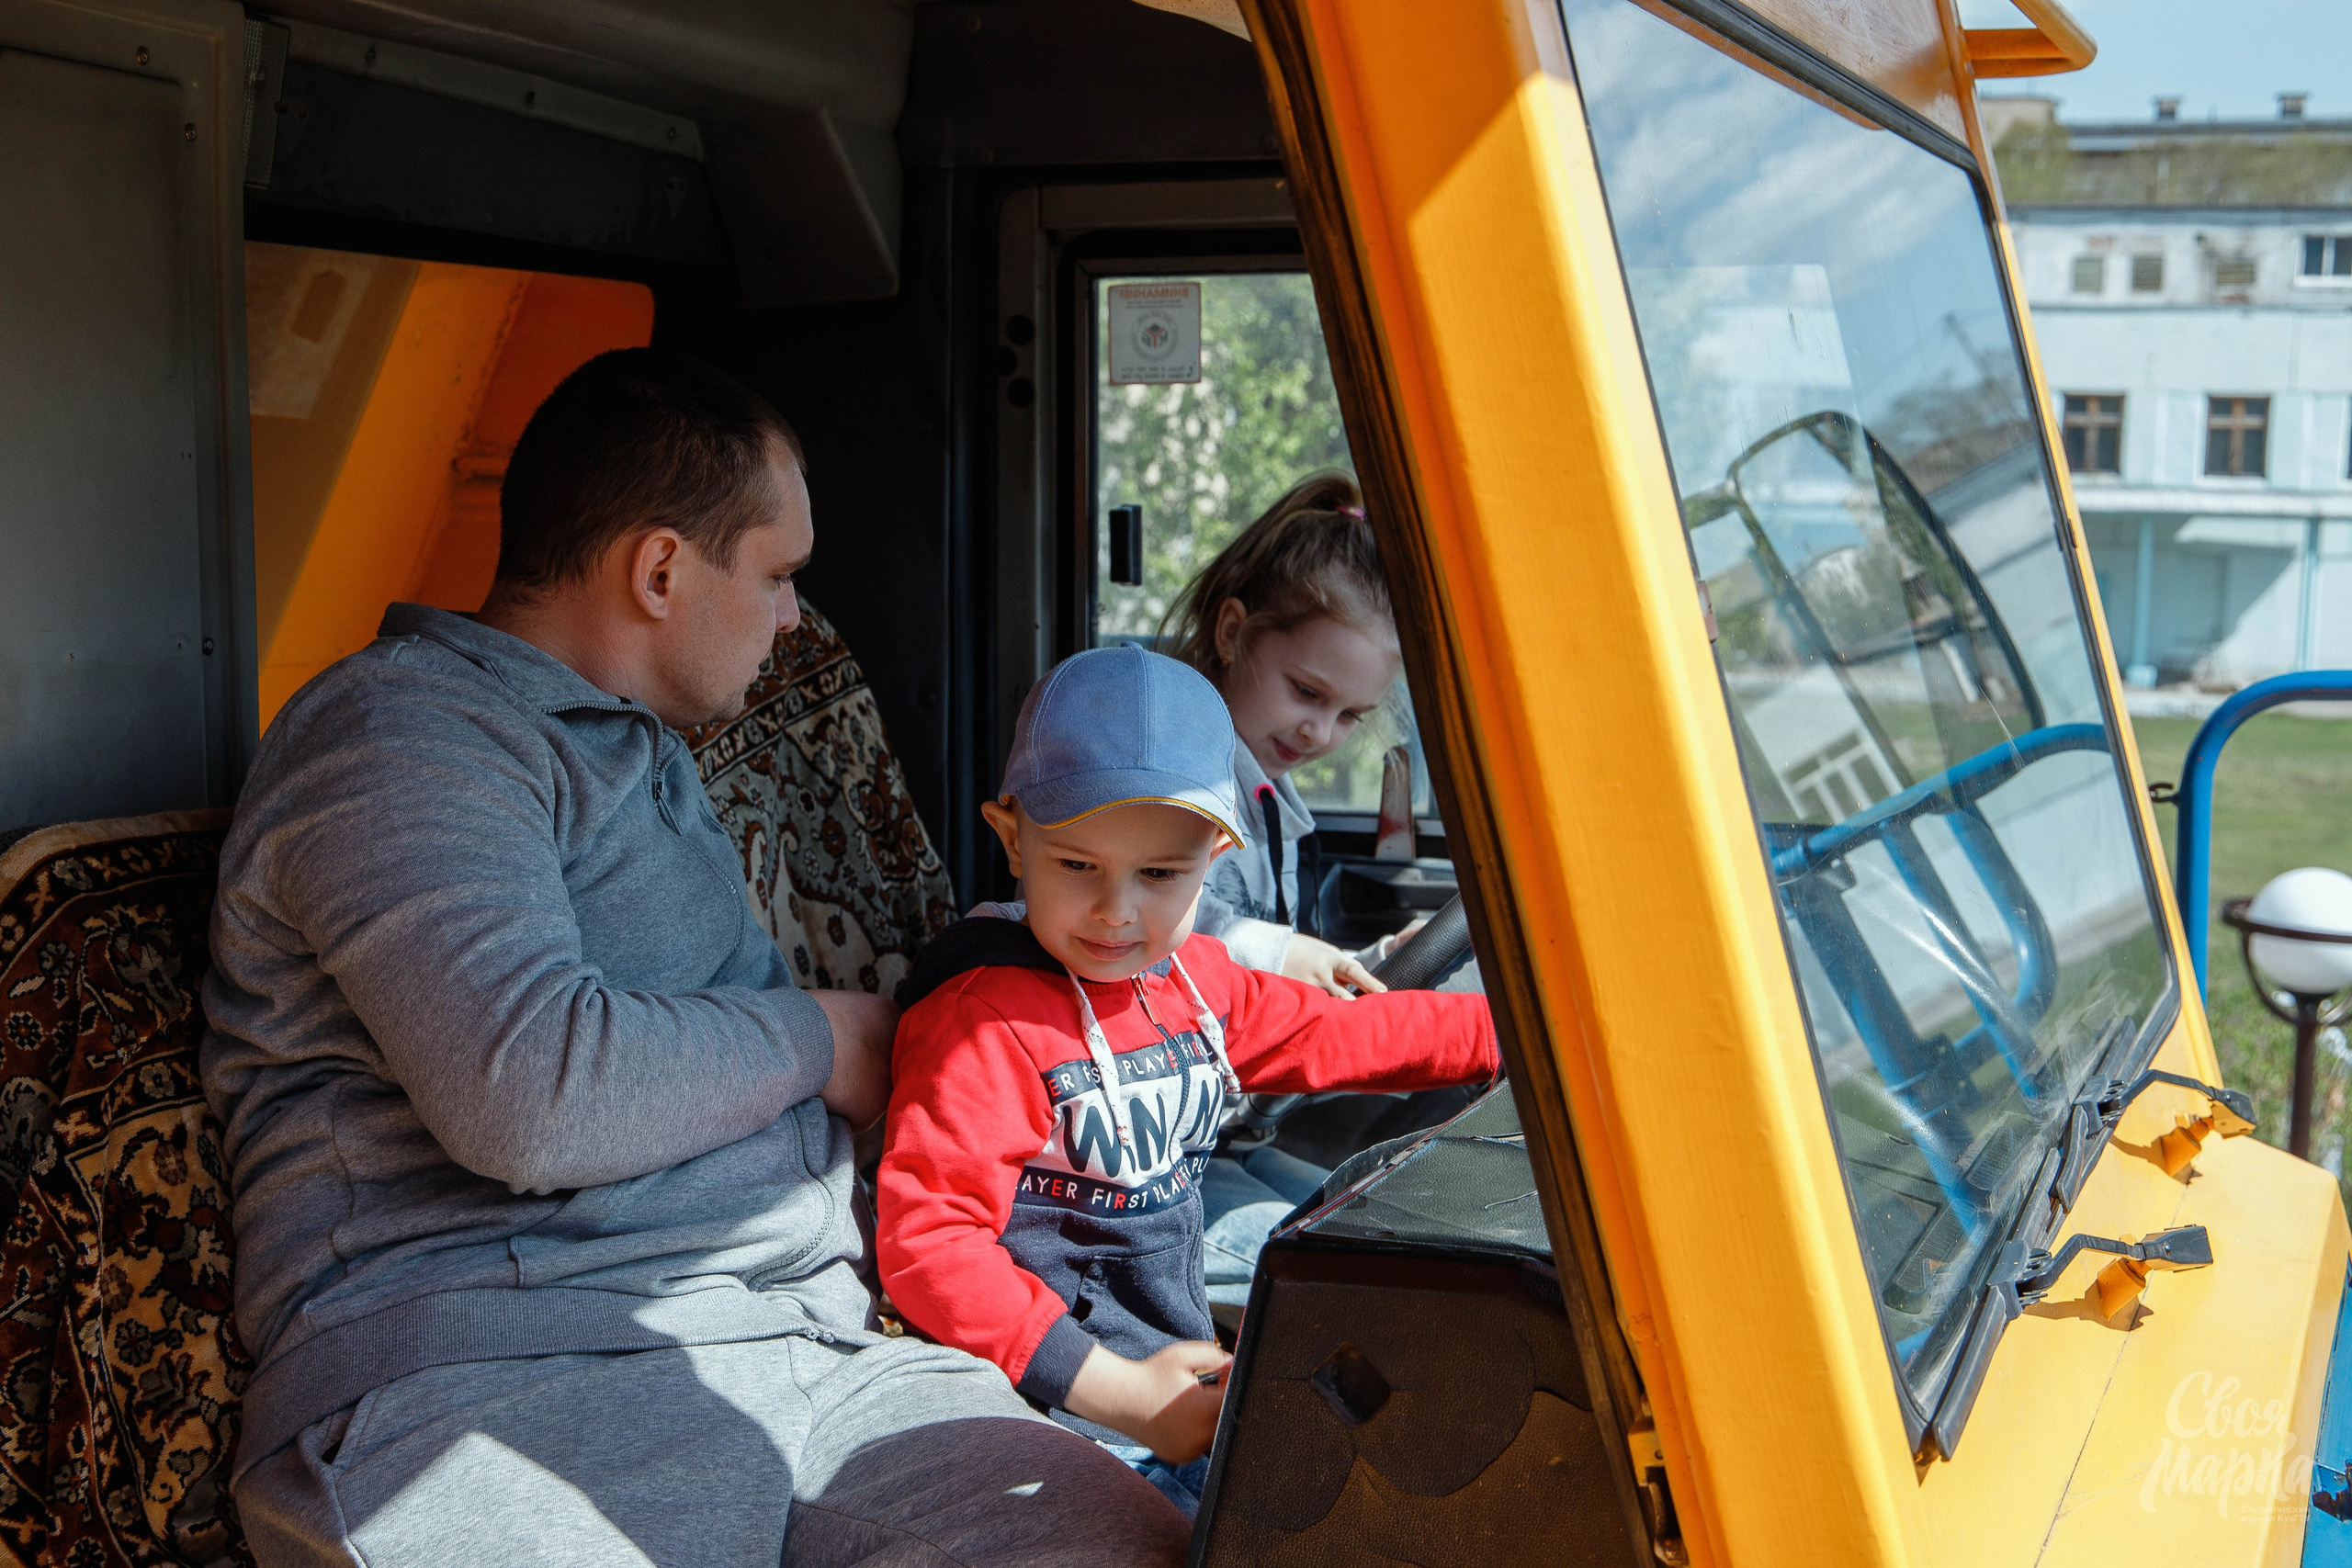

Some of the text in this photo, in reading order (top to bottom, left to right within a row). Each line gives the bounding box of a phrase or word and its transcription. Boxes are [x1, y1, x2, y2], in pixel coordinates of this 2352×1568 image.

[1122, 1050, 1180, 1076] PLAYE
[1014, 1174, 1078, 1200] AYER
[1091, 1188, 1148, 1210] FIRST
